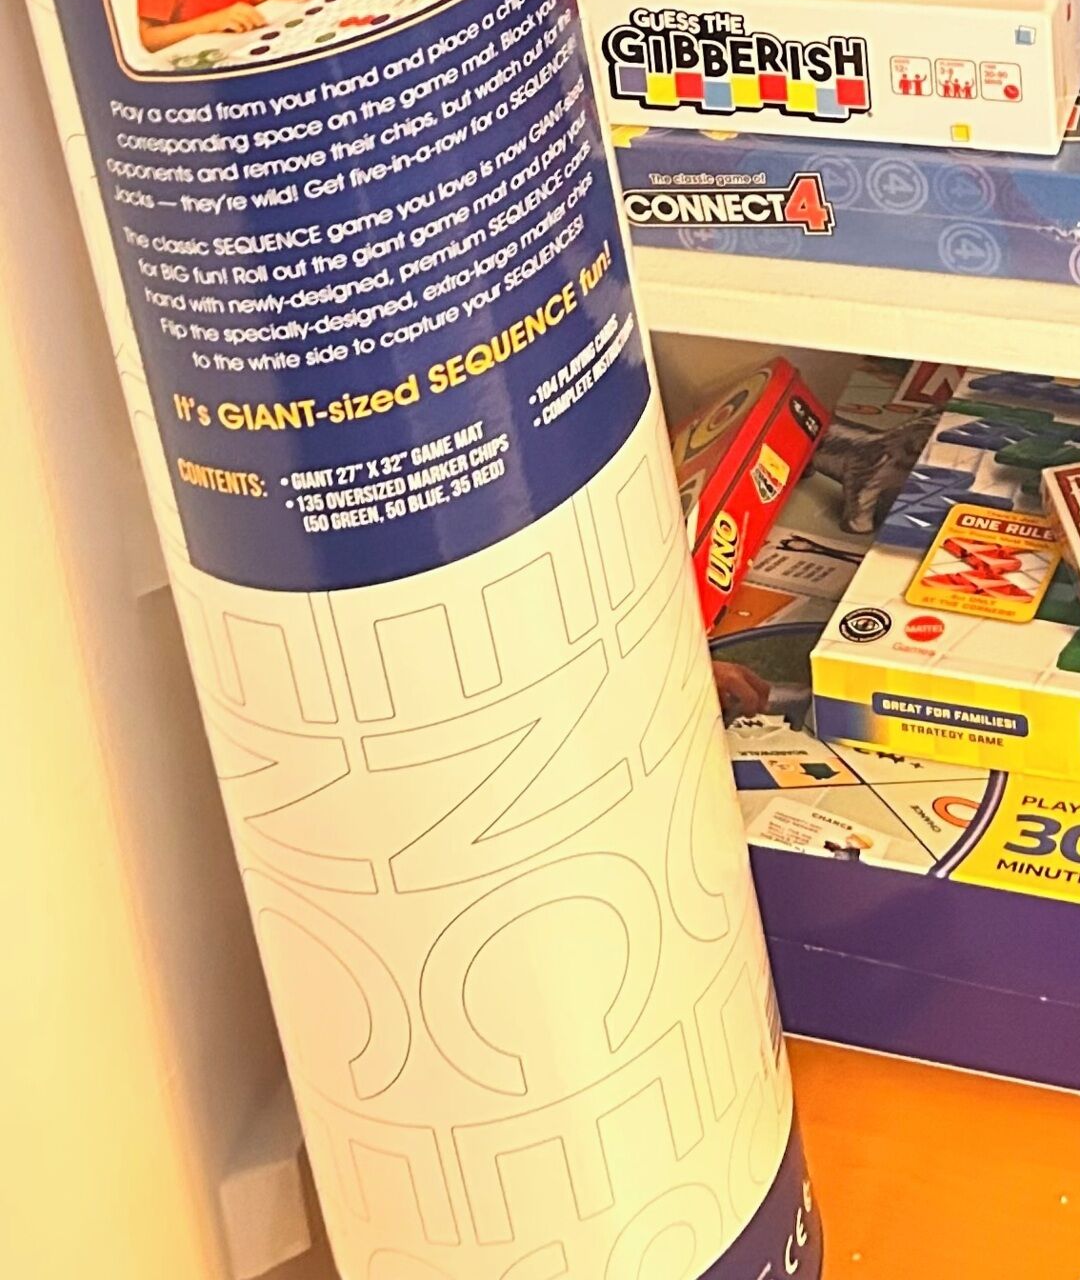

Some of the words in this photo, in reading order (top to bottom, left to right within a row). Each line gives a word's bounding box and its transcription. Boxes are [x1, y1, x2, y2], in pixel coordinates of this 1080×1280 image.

[633, 9, 700, 34] GUESS
[704, 14, 744, 34] THE
[612, 29, 863, 81] GIBBERISH
[625, 194, 785, 222] CONNECT
[785, 179, 827, 230] 4
[174, 394, 210, 426] It's
[218, 374, 420, 431] GIANT-sized
[428, 284, 578, 394] SEQUENCE
[580, 241, 611, 304] fun!
[178, 458, 268, 497] CONTENTS:
[291, 469, 333, 490] GIANT
[411, 440, 453, 466] GAME
[454, 422, 483, 447] MAT
[297, 491, 324, 511] 135
[327, 477, 406, 508] OVERSIZED
[410, 457, 468, 488] MARKER
[471, 434, 510, 466] CHIPS
[882, 699, 921, 715] GREAT
[926, 704, 951, 719] FOR
[954, 708, 1017, 729] FAMILIES!
